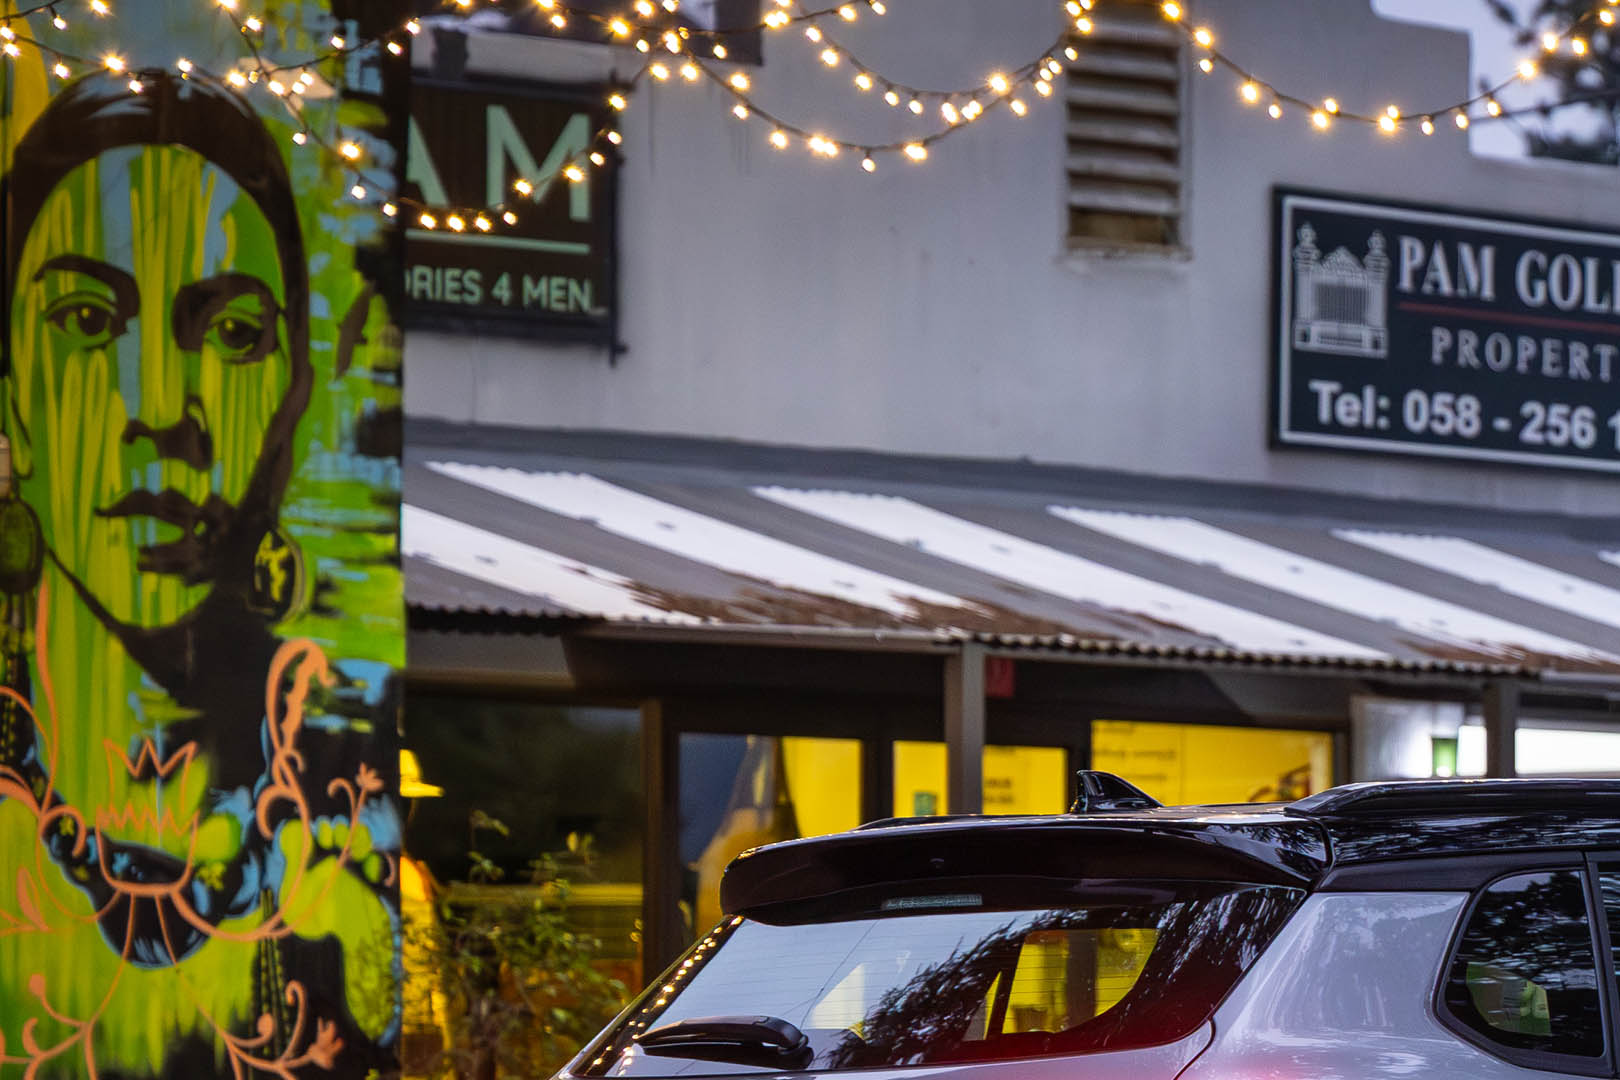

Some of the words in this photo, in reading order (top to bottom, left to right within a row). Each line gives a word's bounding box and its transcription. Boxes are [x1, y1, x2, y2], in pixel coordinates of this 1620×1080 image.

[405, 264, 483, 305] RIES
[491, 271, 513, 306] 4
[522, 274, 592, 313] MEN
[1398, 235, 1496, 300] PAM
[1308, 379, 1390, 430] Tel:
[1403, 389, 1482, 439] 058
[1519, 401, 1597, 449] 256
